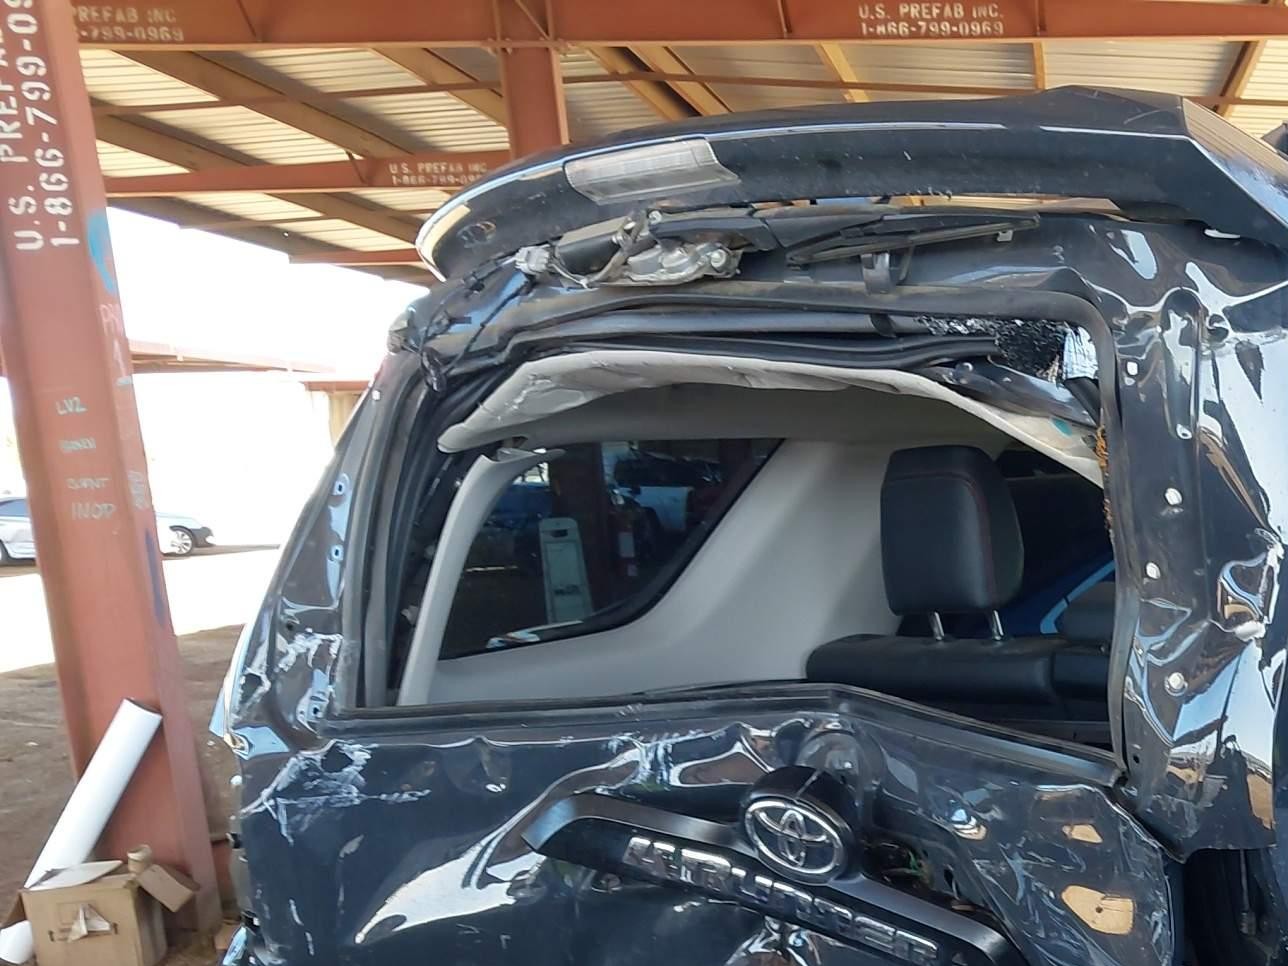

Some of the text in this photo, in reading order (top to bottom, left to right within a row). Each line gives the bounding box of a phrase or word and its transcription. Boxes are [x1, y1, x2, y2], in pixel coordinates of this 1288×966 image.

[858, 3, 891, 20] U.S.
[899, 3, 964, 19] PREFAB
[861, 21, 1004, 36] 1-866-799-0969
[7, 183, 45, 251] U.S.
